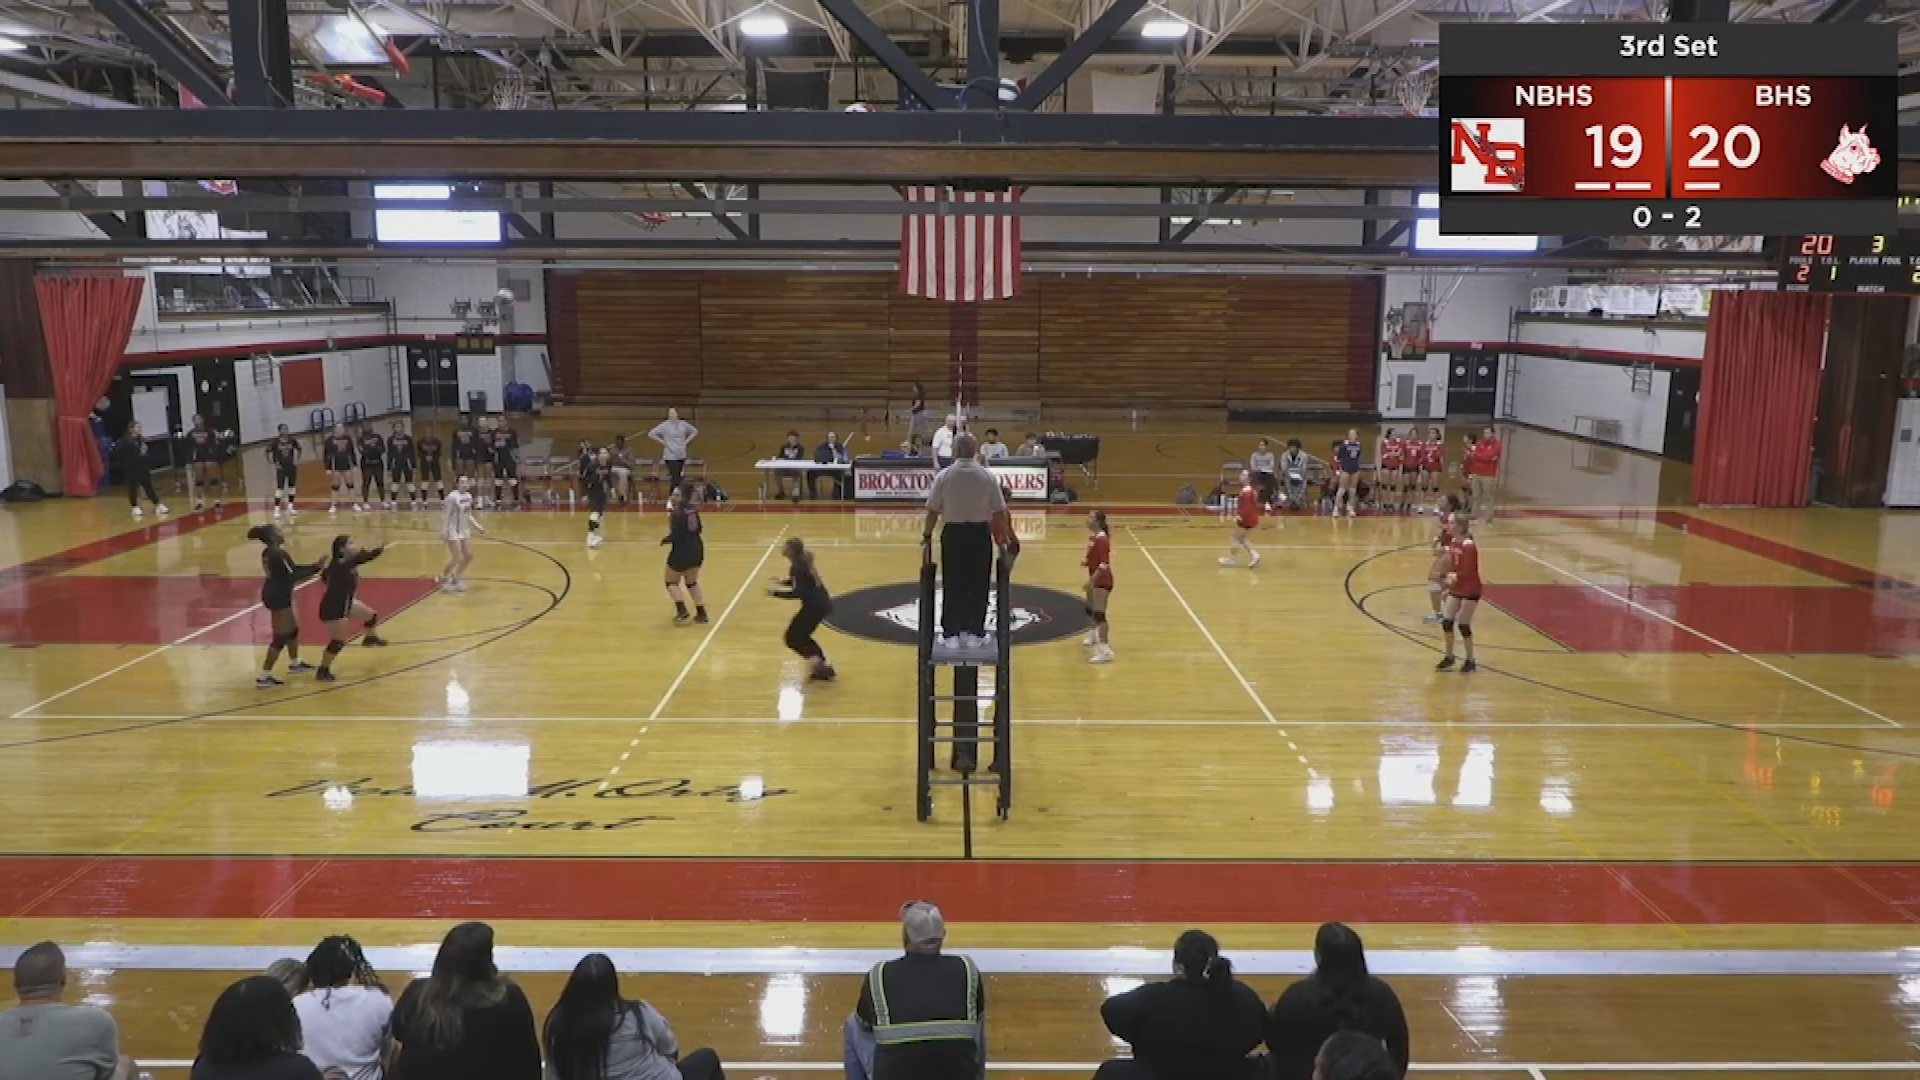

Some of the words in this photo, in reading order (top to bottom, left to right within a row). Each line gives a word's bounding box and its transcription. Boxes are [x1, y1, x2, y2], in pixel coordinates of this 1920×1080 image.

[1801, 234, 1833, 254] 20
[1872, 235, 1885, 253] 3
[1848, 257, 1879, 265] PLAYER
[1797, 265, 1811, 281] 2
[1856, 285, 1885, 293] MATCH
[410, 809, 674, 831] Court
